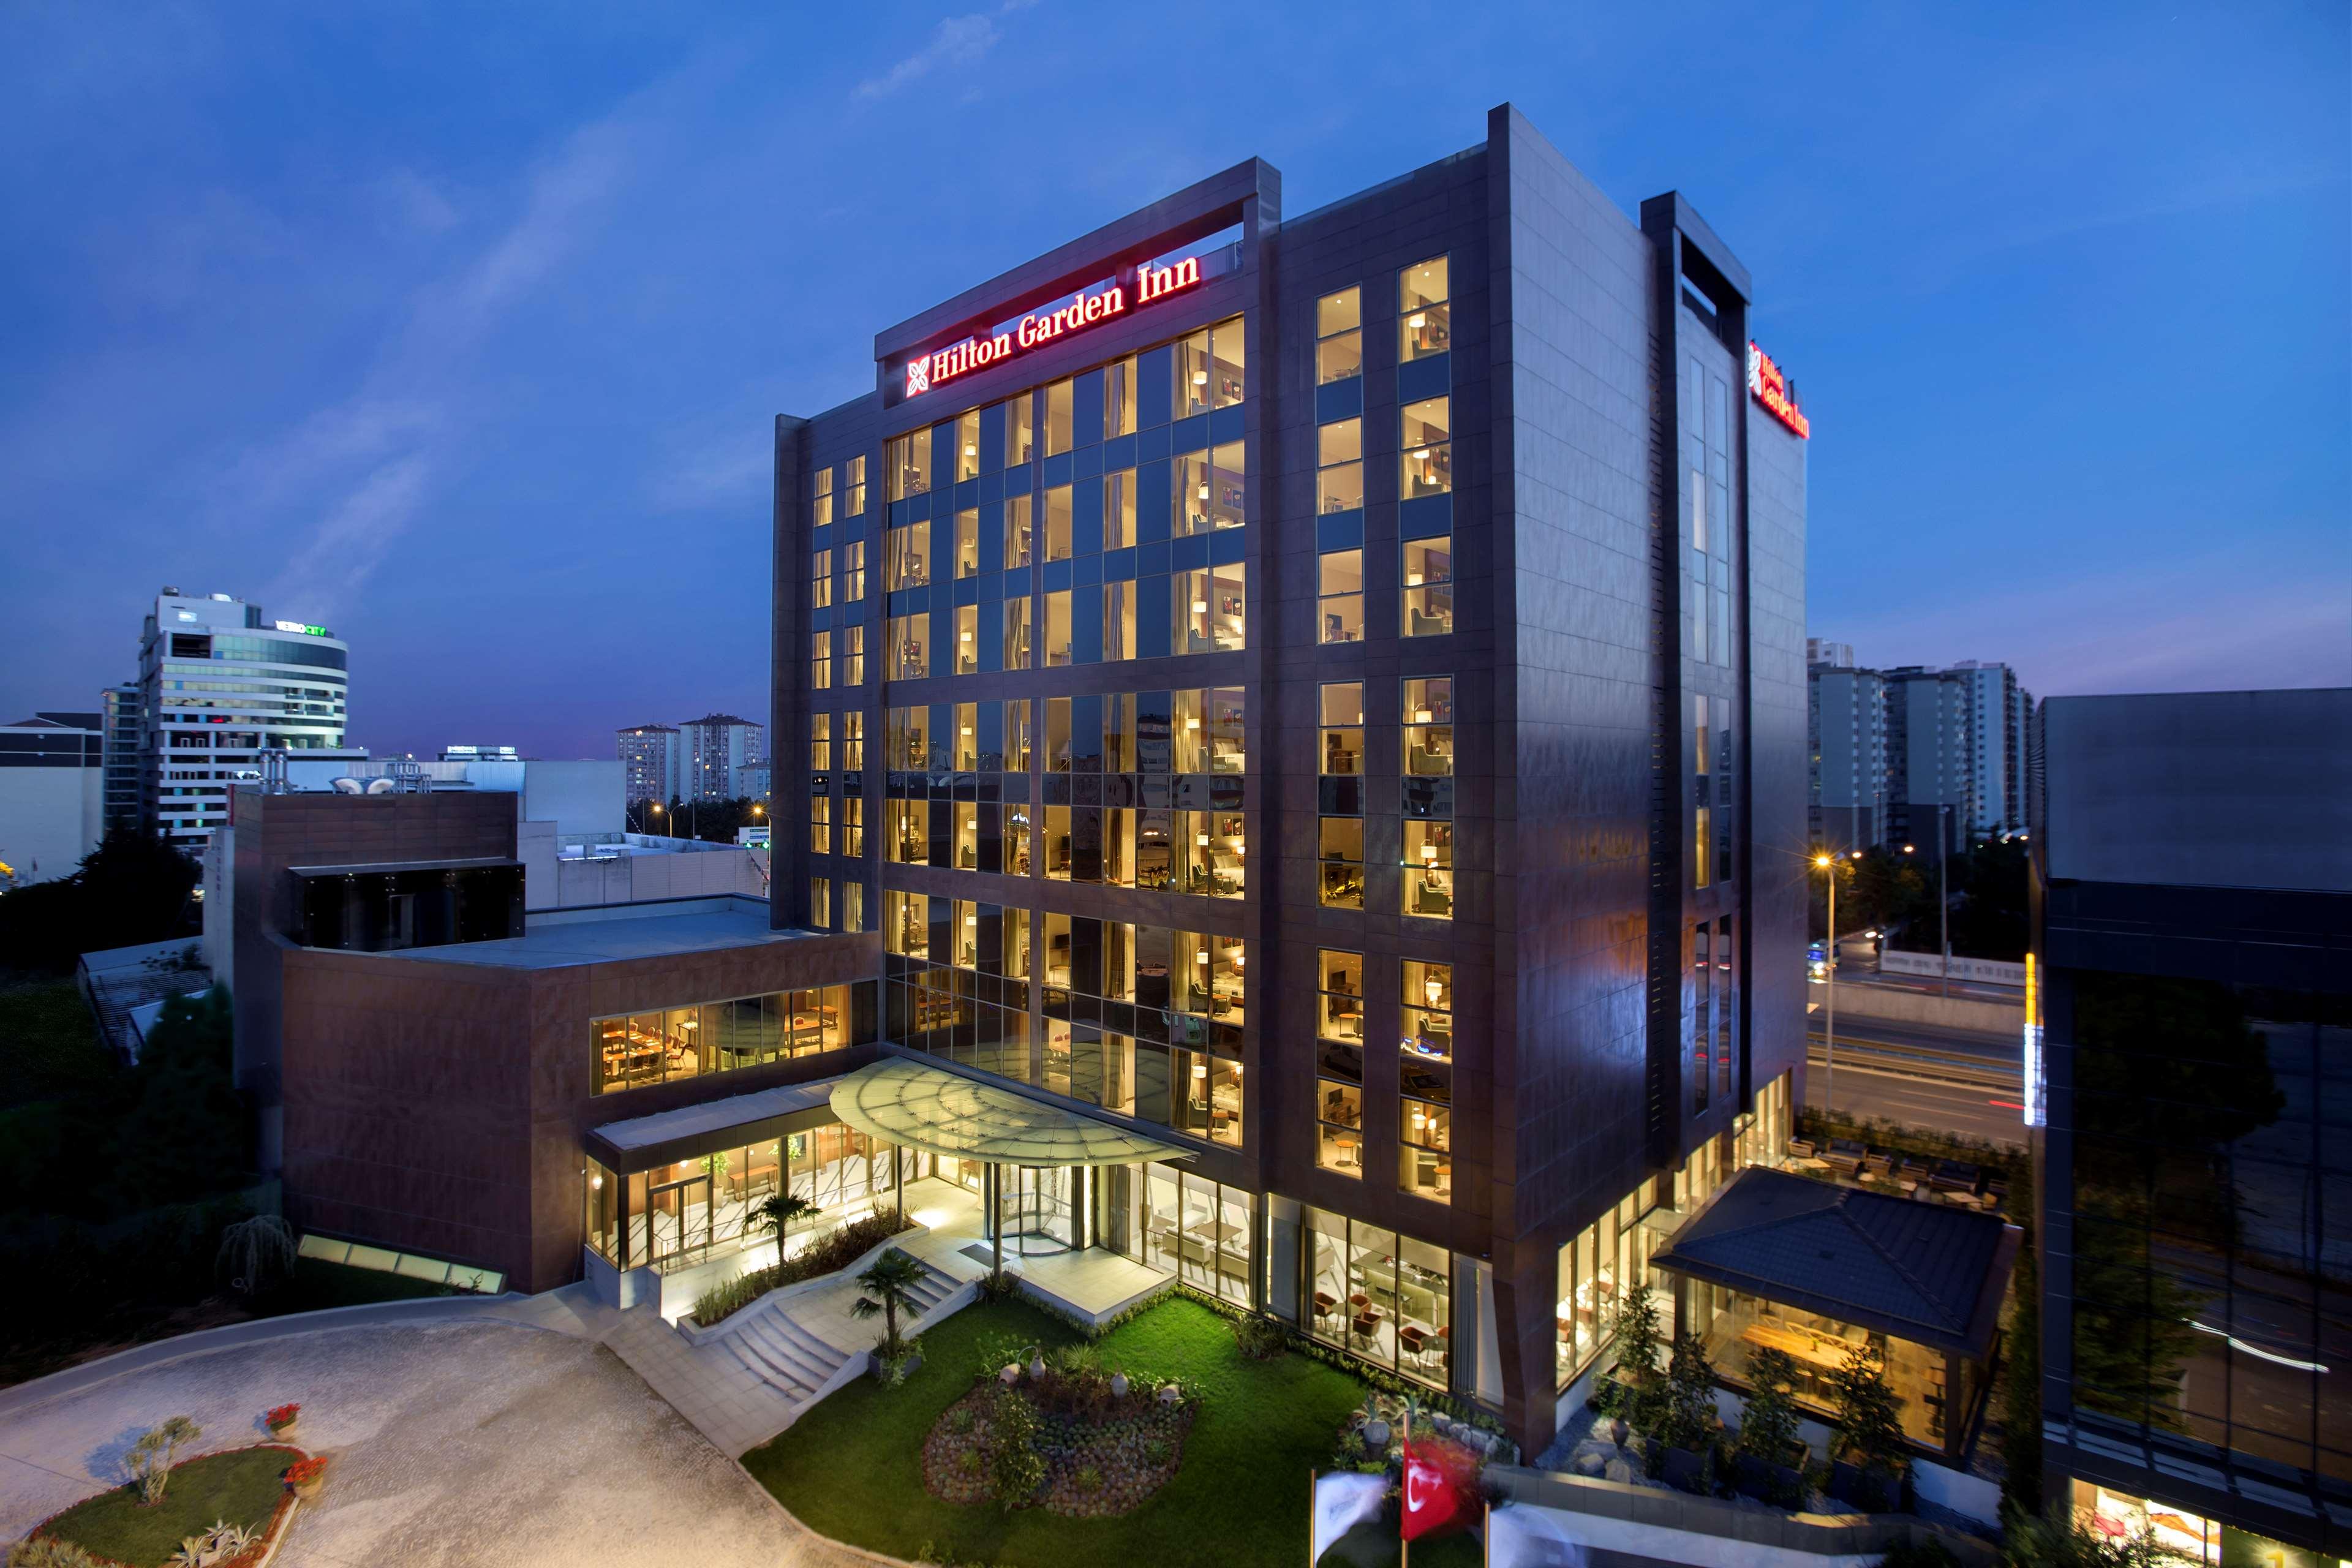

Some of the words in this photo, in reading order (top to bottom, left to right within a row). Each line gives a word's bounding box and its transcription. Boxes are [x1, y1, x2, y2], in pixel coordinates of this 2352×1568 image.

[931, 333, 1012, 383] Hilton
[1018, 287, 1125, 348] Garden
[1137, 257, 1200, 303] Inn
